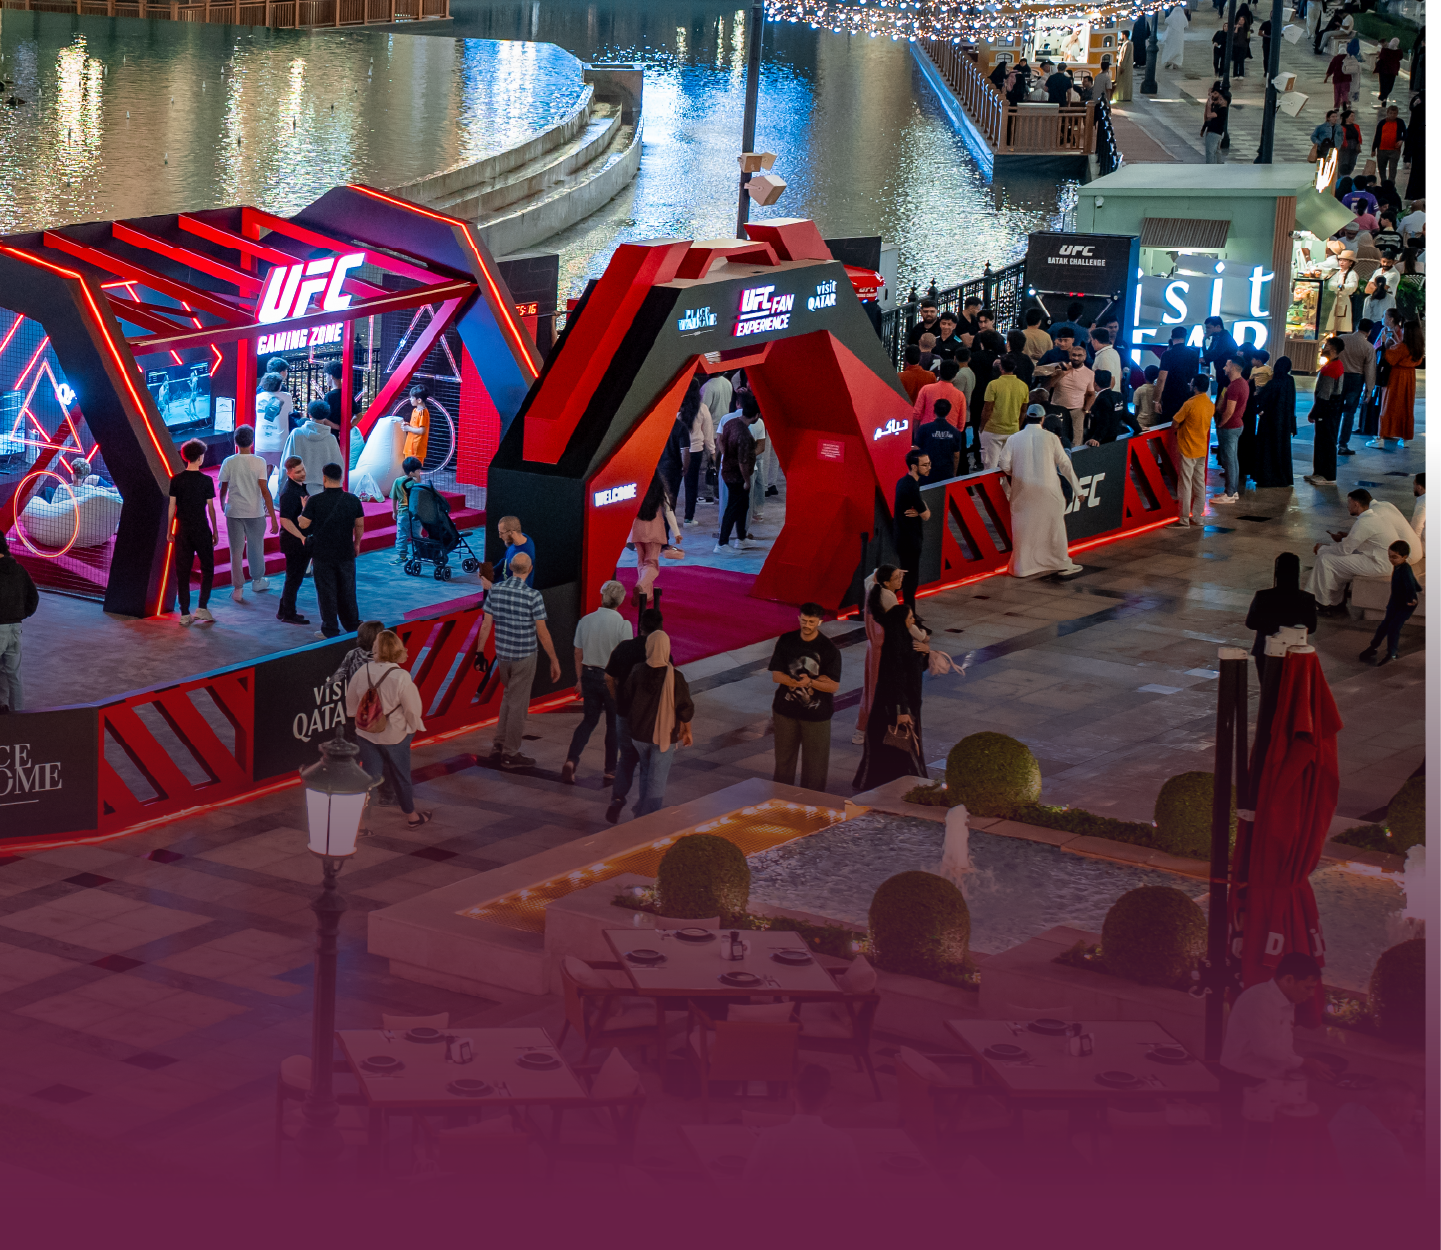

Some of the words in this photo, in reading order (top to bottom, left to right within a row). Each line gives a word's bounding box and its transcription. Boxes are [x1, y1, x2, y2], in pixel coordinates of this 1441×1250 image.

[1059, 245, 1095, 256] UFC
[1069, 258, 1106, 267] CHALLENGE
[256, 252, 365, 323] UFC
[740, 284, 775, 312] UFC
[771, 294, 795, 314] FAN
[1133, 261, 1274, 327] isit
[807, 293, 837, 312] QATAR
[257, 328, 309, 356] GAMING
[308, 322, 343, 346] ZONE
[735, 314, 791, 337] EXPERIENCE
[594, 483, 637, 507] WELCOME
[292, 701, 346, 743] QATA
